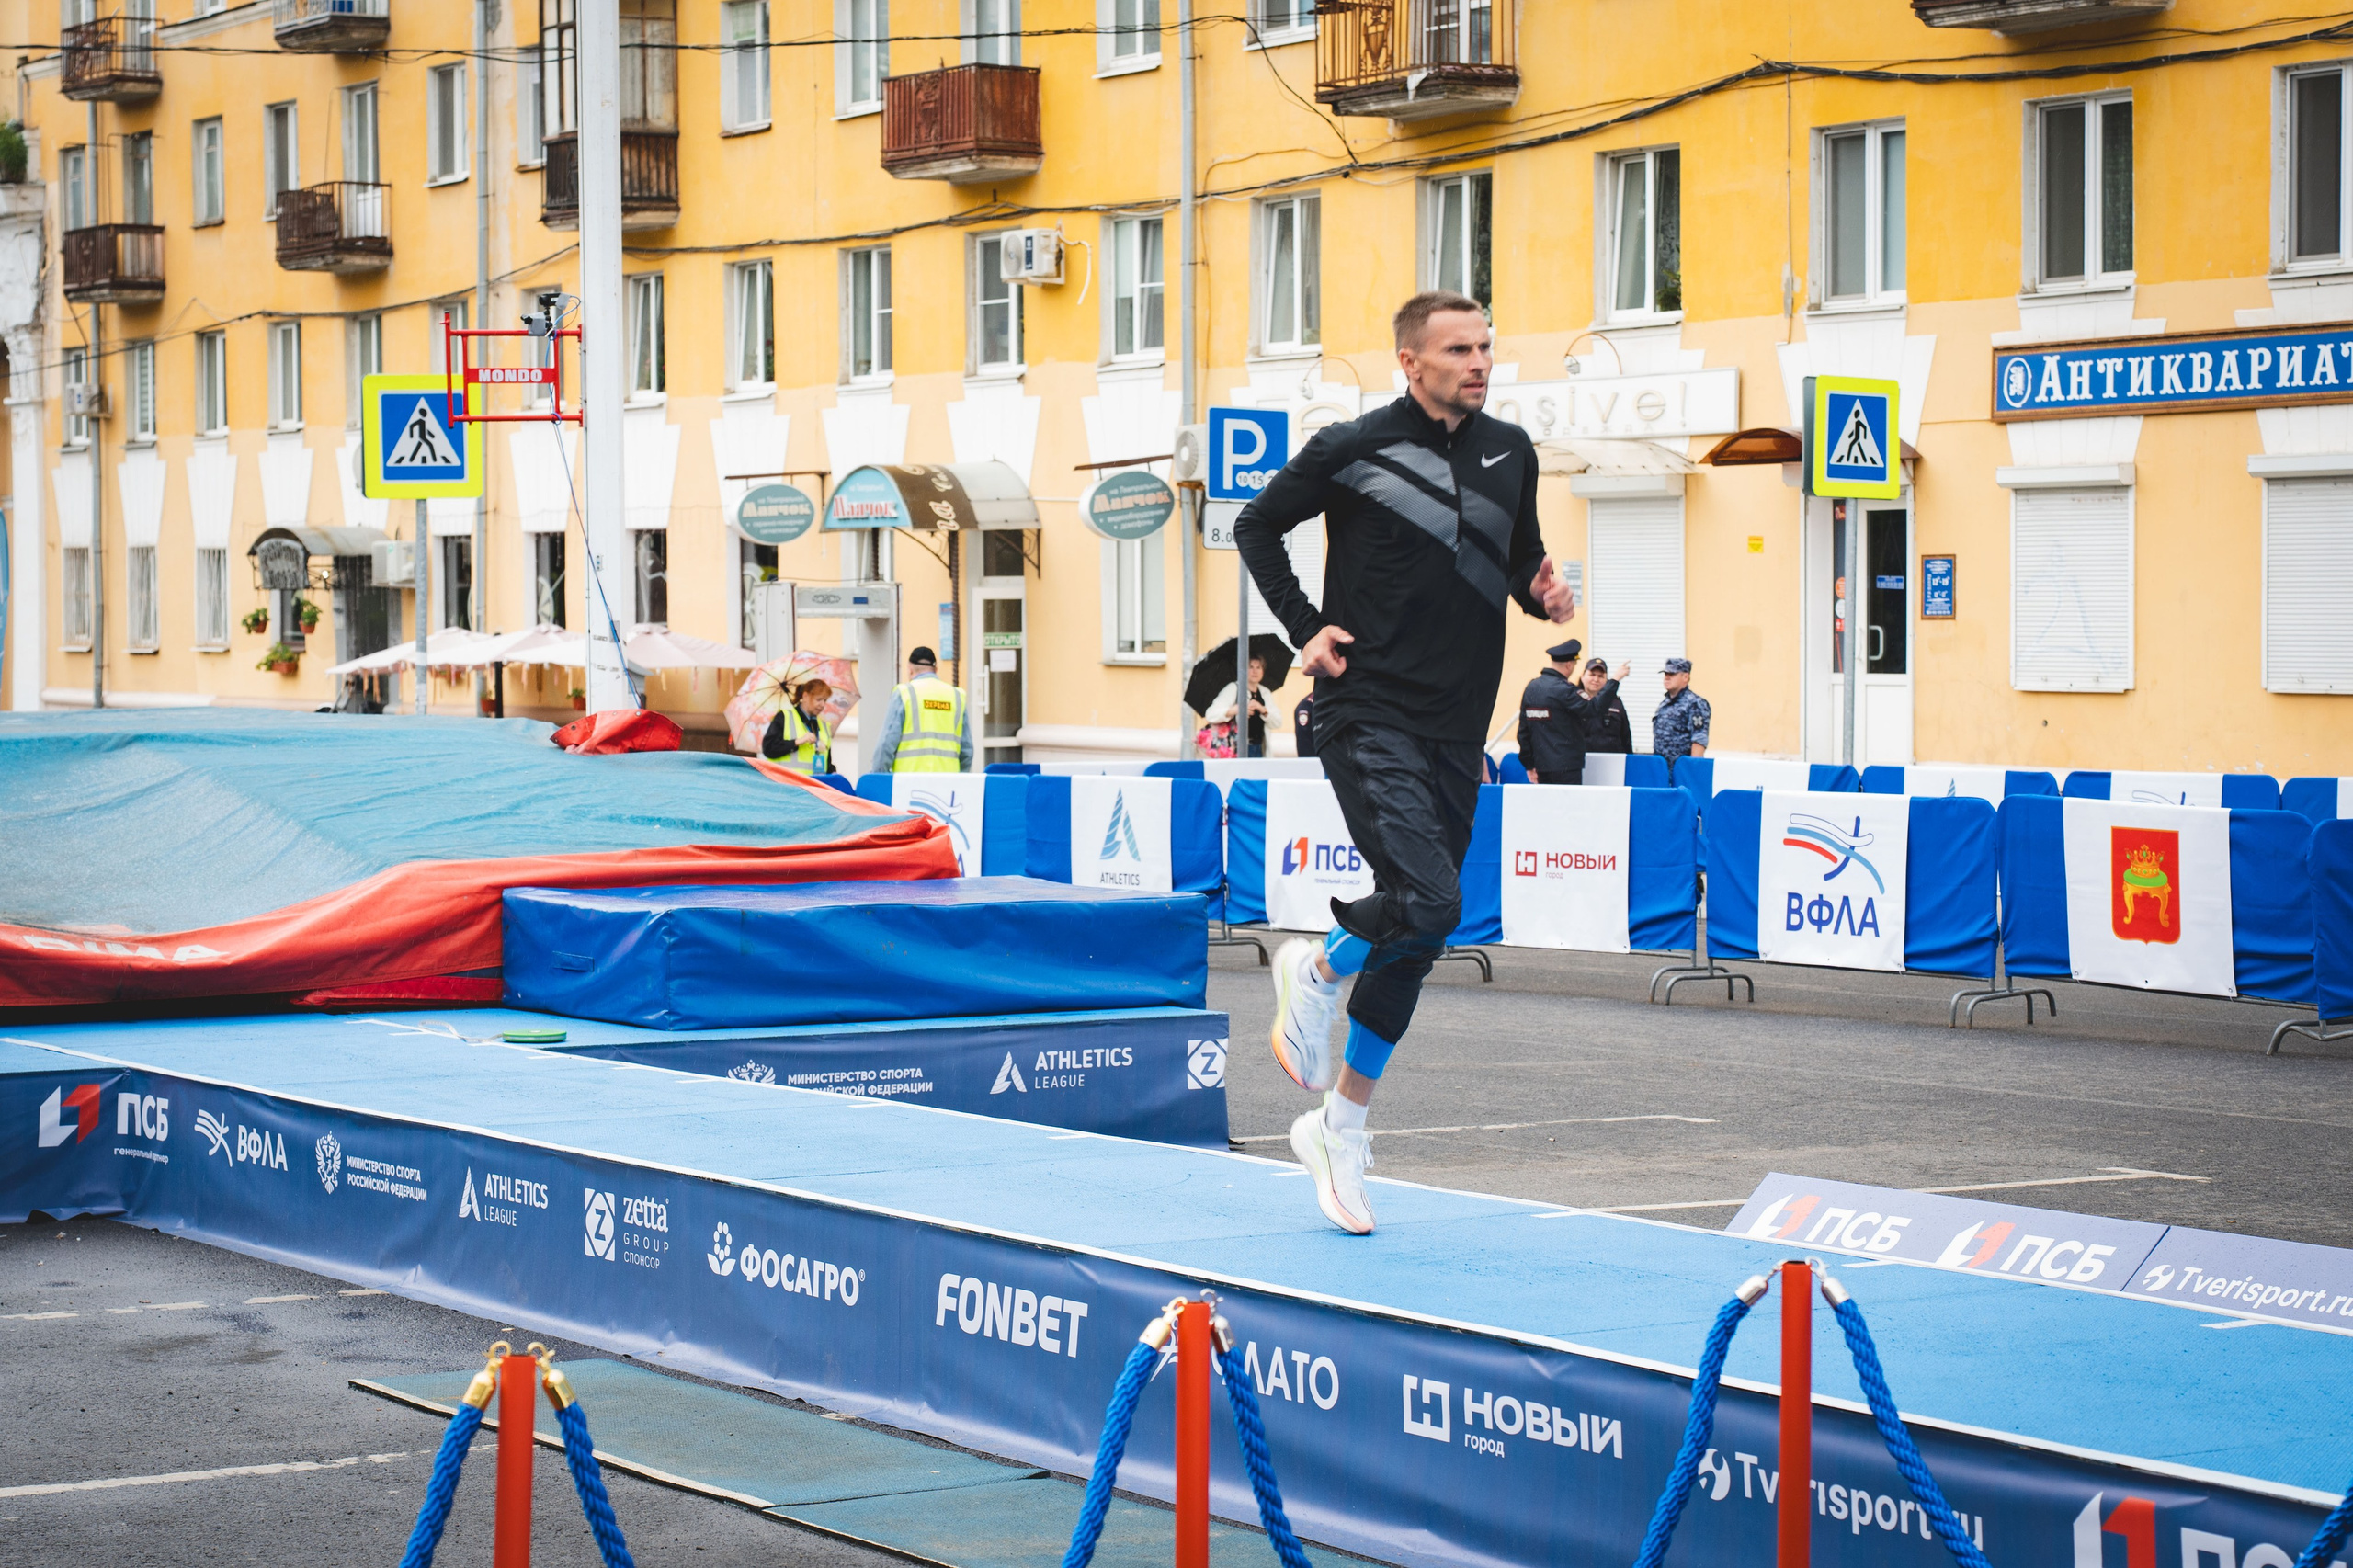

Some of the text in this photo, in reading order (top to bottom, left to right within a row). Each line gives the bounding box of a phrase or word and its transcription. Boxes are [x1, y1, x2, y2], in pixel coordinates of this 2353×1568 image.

[478, 369, 543, 382] MONDO
[1222, 418, 1267, 491] P
[1238, 475, 1248, 483] 10
[1252, 475, 1264, 485] 15
[1211, 528, 1237, 543] 8.0
[984, 634, 1021, 645] ОТКРЫТО
[1315, 844, 1362, 872] ПСБ
[1545, 851, 1617, 871] НОВЫЙ
[1099, 872, 1141, 886] ATHLETICS
[1786, 892, 1881, 938] ВФЛА
[1035, 1046, 1134, 1072] ATHLETICS
[788, 1068, 923, 1085] МИНИСТЕРСТВО СПОРТА
[868, 1081, 933, 1096] ФЕДЕРАЦИИ
[1035, 1074, 1086, 1090] LEAGUE
[117, 1092, 169, 1142] ПСБ
[237, 1124, 289, 1172] ВФЛА
[347, 1155, 422, 1183] МИНИСТЕРСТВО СПОРТА
[347, 1172, 428, 1202] РОССИЙСКОЙ ФЕДЕРАЦИИ
[484, 1172, 550, 1210] ATHLETICS
[484, 1205, 517, 1228] LEAGUE
[1804, 1207, 1913, 1253] ПСБ
[623, 1232, 670, 1255] GROUP
[623, 1250, 661, 1270] СПОНСОР
[1999, 1233, 2118, 1284] ПСБ
[935, 1272, 1089, 1358] FONBET
[1463, 1387, 1624, 1460] НОВЫЙ
[1464, 1432, 1506, 1459] город
